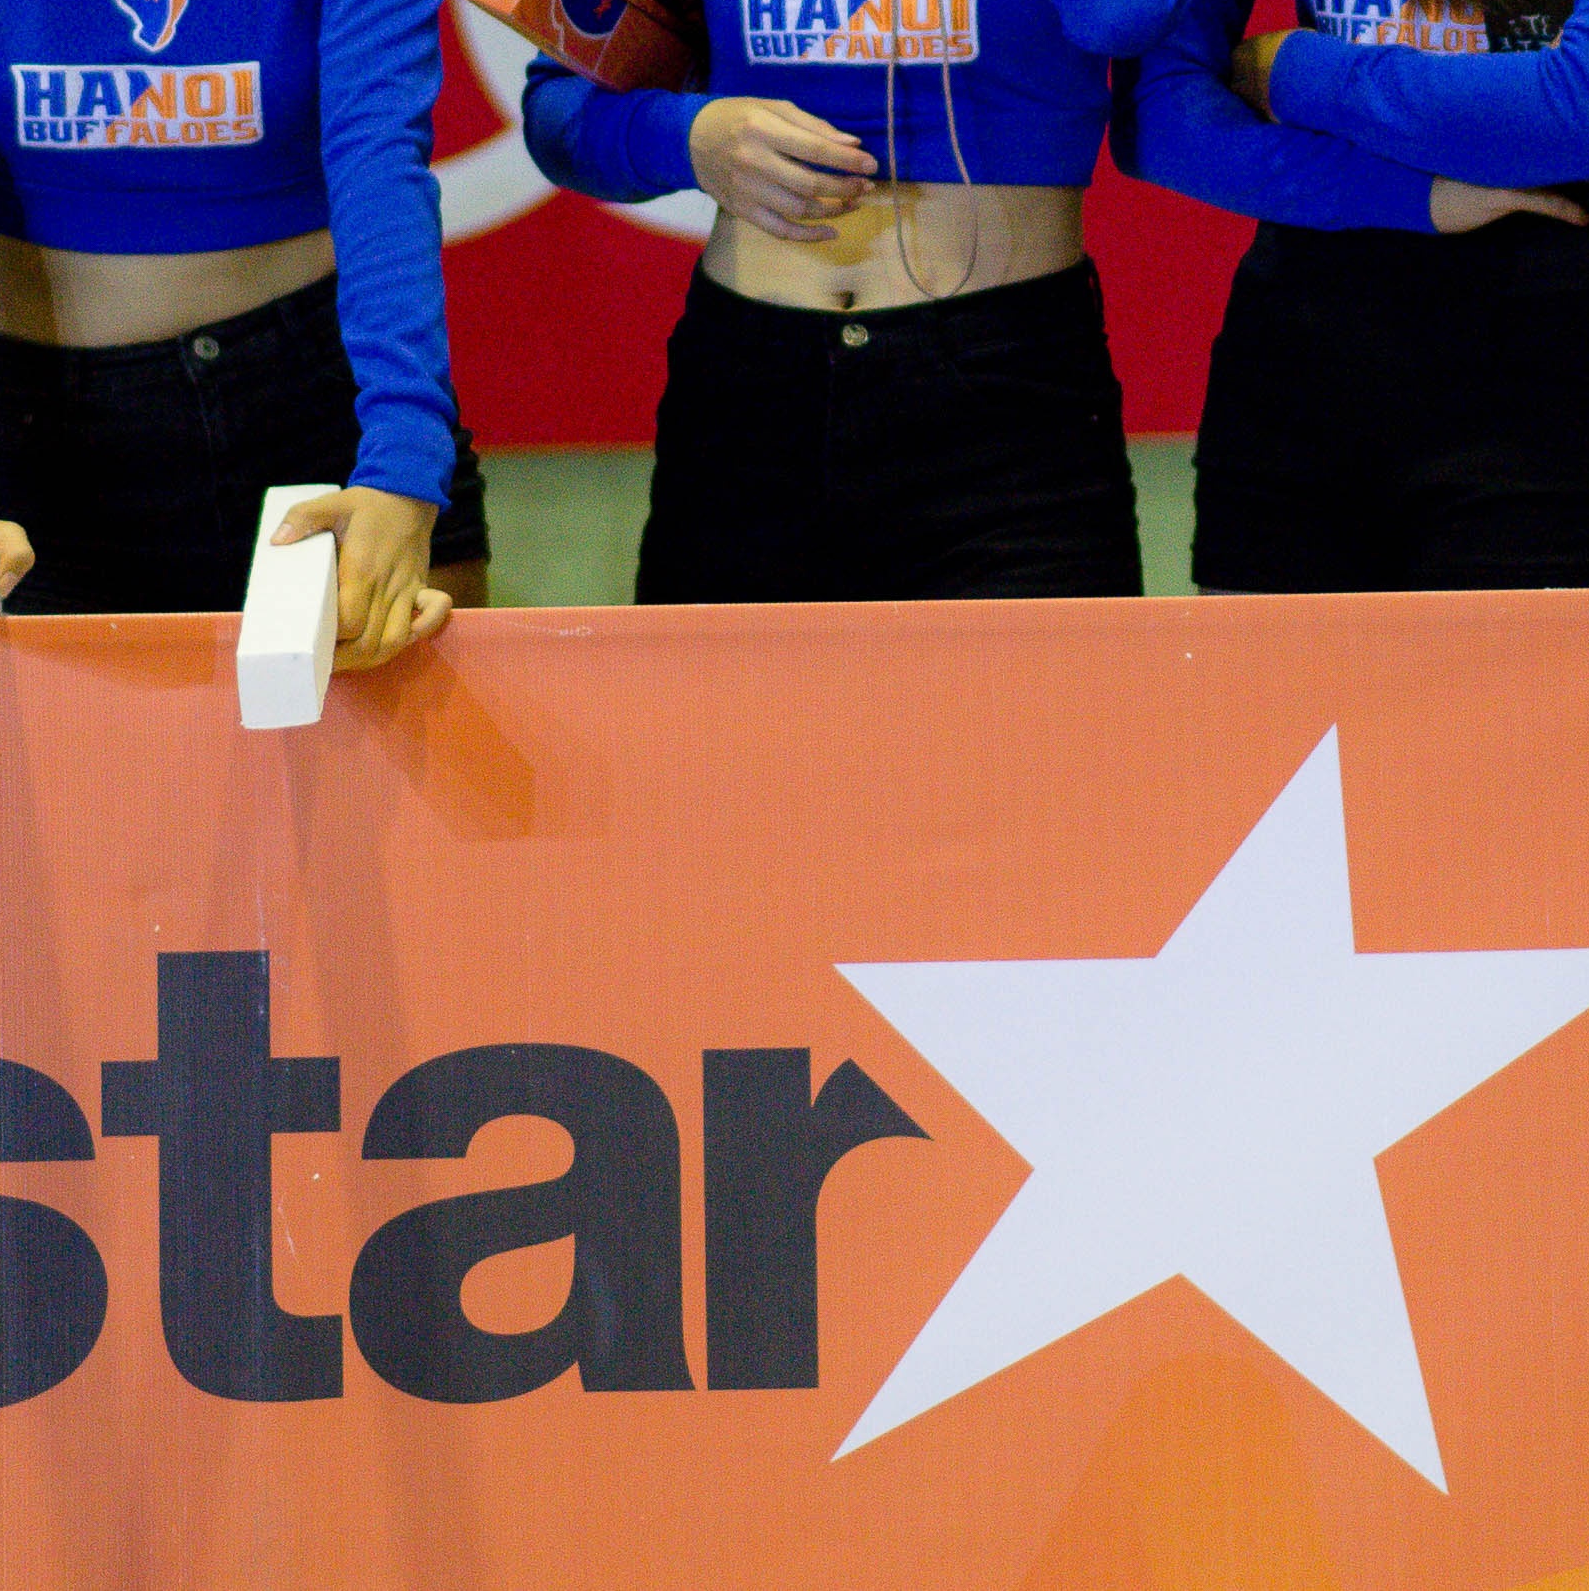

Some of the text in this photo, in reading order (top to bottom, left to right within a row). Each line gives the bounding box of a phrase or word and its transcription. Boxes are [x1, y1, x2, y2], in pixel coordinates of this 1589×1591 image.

[748, 33, 973, 59] BUFFALOES
[20, 68, 254, 119] HANOI
[22, 118, 259, 145] BUFFALOES
